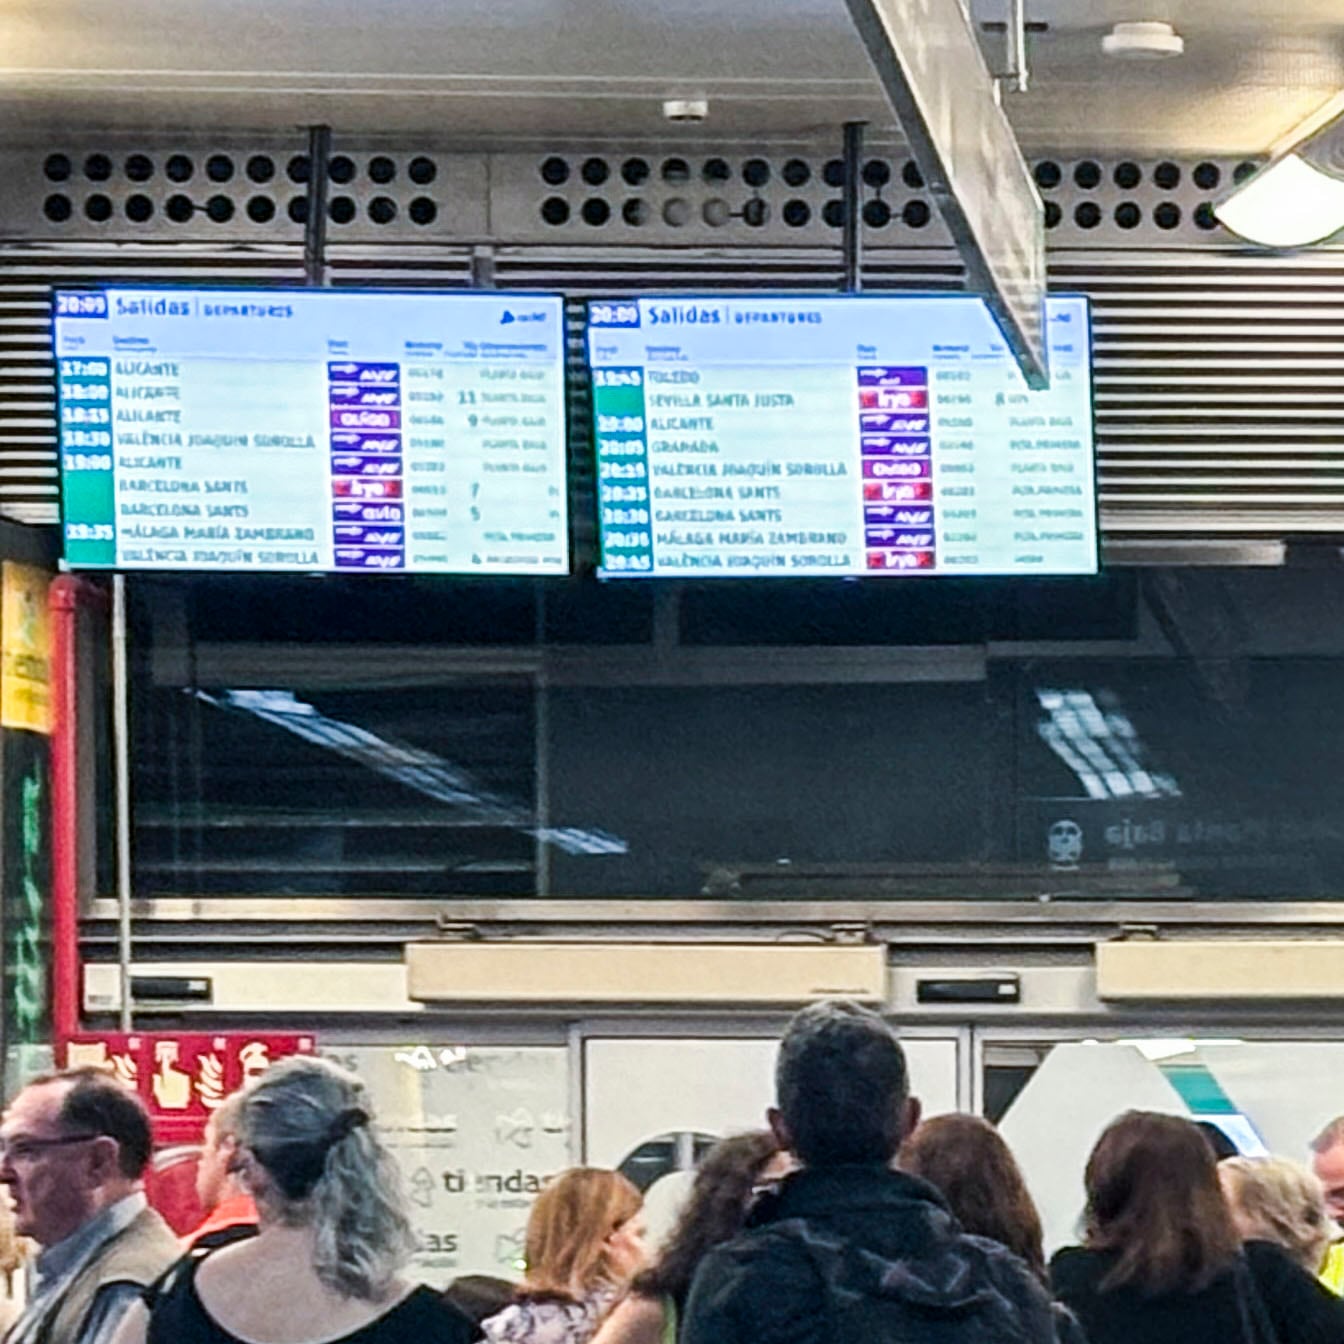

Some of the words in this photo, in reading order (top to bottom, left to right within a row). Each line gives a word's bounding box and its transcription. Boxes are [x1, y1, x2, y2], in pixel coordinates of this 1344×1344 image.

[116, 297, 190, 317] Salidas
[203, 304, 294, 318] DEPARTURES
[649, 306, 721, 325] Salidas
[735, 312, 823, 325] DEPARTURES
[115, 362, 180, 377] ALICANTE
[648, 370, 700, 384] TOLEDO
[116, 386, 181, 400] ALICANTE
[649, 393, 701, 408] SEVILLA
[706, 394, 750, 408] SANTA
[754, 393, 795, 408] JUSTA
[116, 409, 182, 424] ALICANTE
[650, 417, 714, 431] ALICANTE
[651, 440, 720, 454] GRANADA
[119, 456, 183, 470] ALICANTE
[786, 462, 848, 477] SOROLLA
[119, 479, 200, 493] BARCELONA
[204, 480, 248, 494] SANTS
[653, 486, 733, 500] BARCELONA
[738, 486, 781, 500] SANTS
[120, 503, 201, 518] BARCELONA
[207, 504, 249, 518] SANTS
[655, 509, 736, 523] BARCELONA
[738, 509, 783, 523] SANTS
[234, 527, 315, 542] ZAMBRANO
[656, 530, 714, 545] MÁLAGA
[718, 530, 764, 545] MARÍA
[768, 531, 848, 546] ZAMBRANO
[257, 551, 319, 565] SOROLLA
[791, 554, 851, 568] SOROLLA
